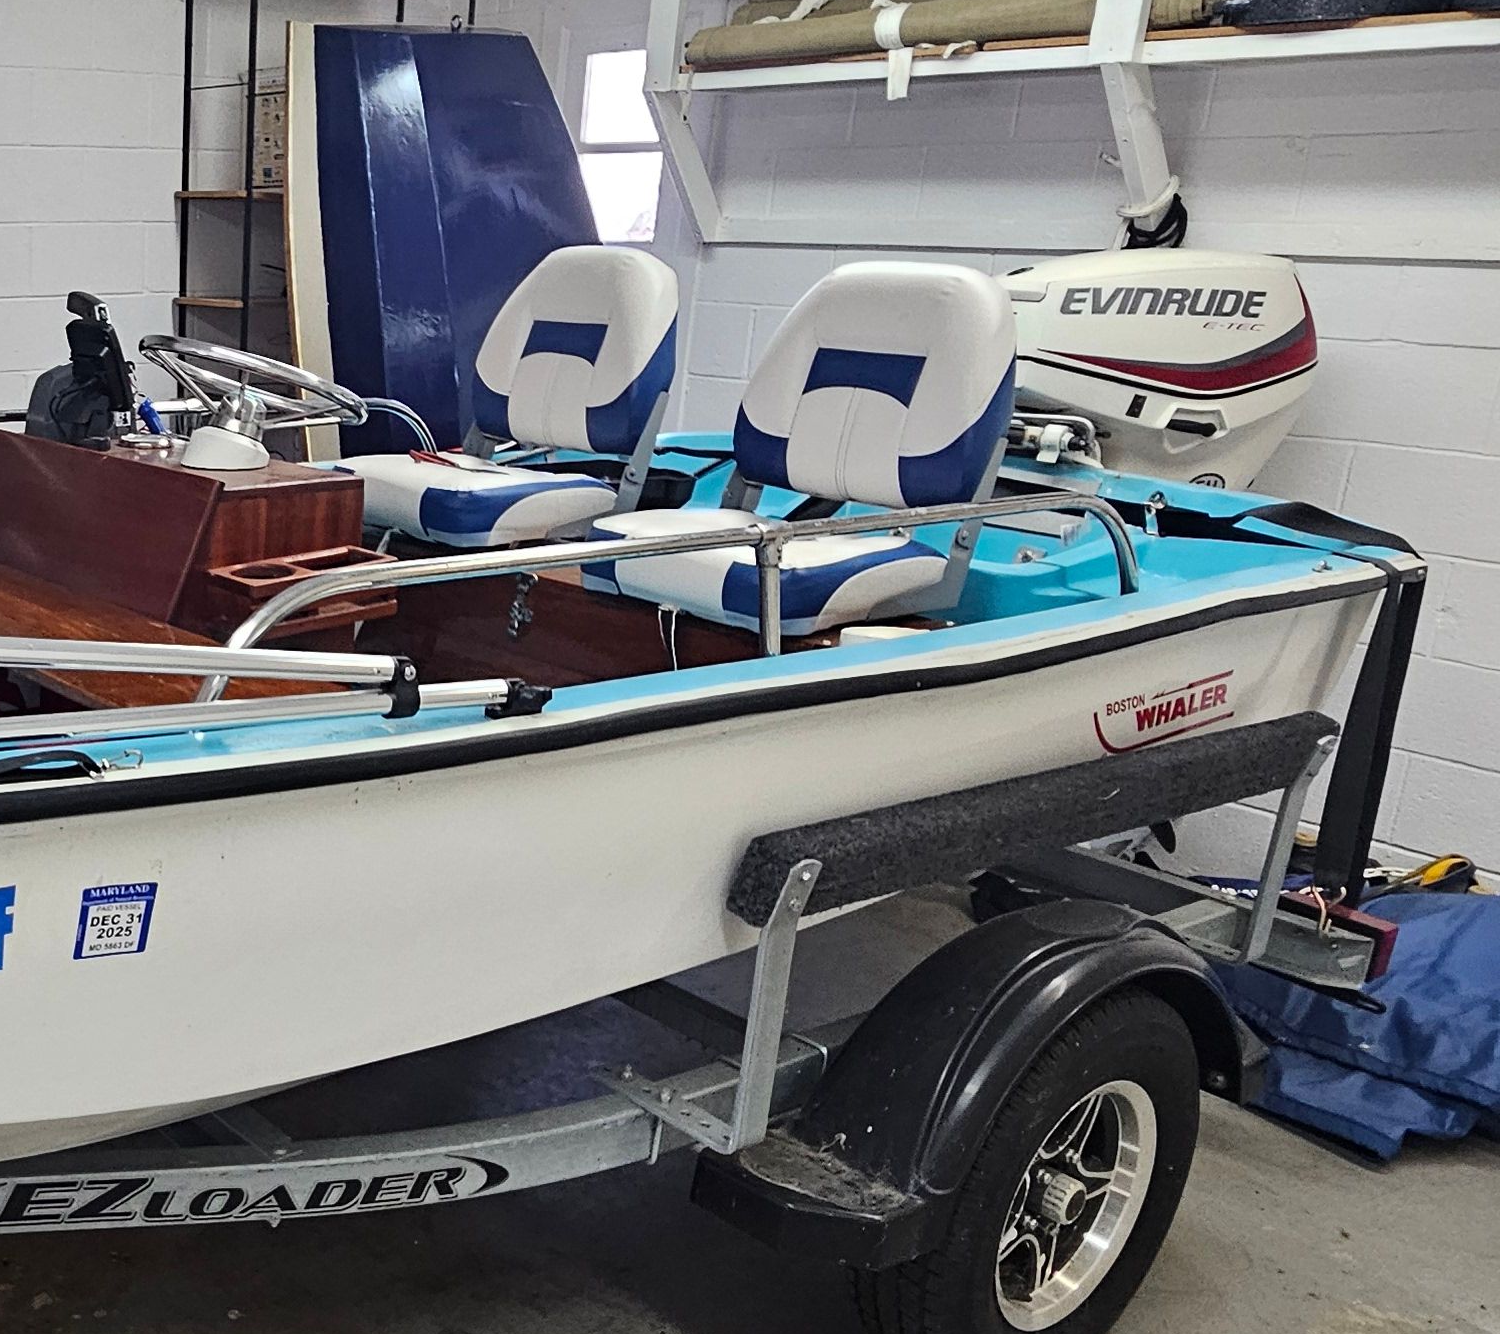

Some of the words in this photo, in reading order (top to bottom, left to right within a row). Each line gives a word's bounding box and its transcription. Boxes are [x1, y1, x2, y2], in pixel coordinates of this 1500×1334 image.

[1060, 287, 1267, 318] EVINRUDE
[1202, 322, 1267, 332] E-TEC
[1106, 693, 1146, 716] BOSTON
[1135, 684, 1228, 732] WHALER
[89, 884, 151, 898] MARYLAND
[90, 914, 121, 927] DEC
[126, 913, 142, 924] 31
[96, 926, 133, 939] 2025
